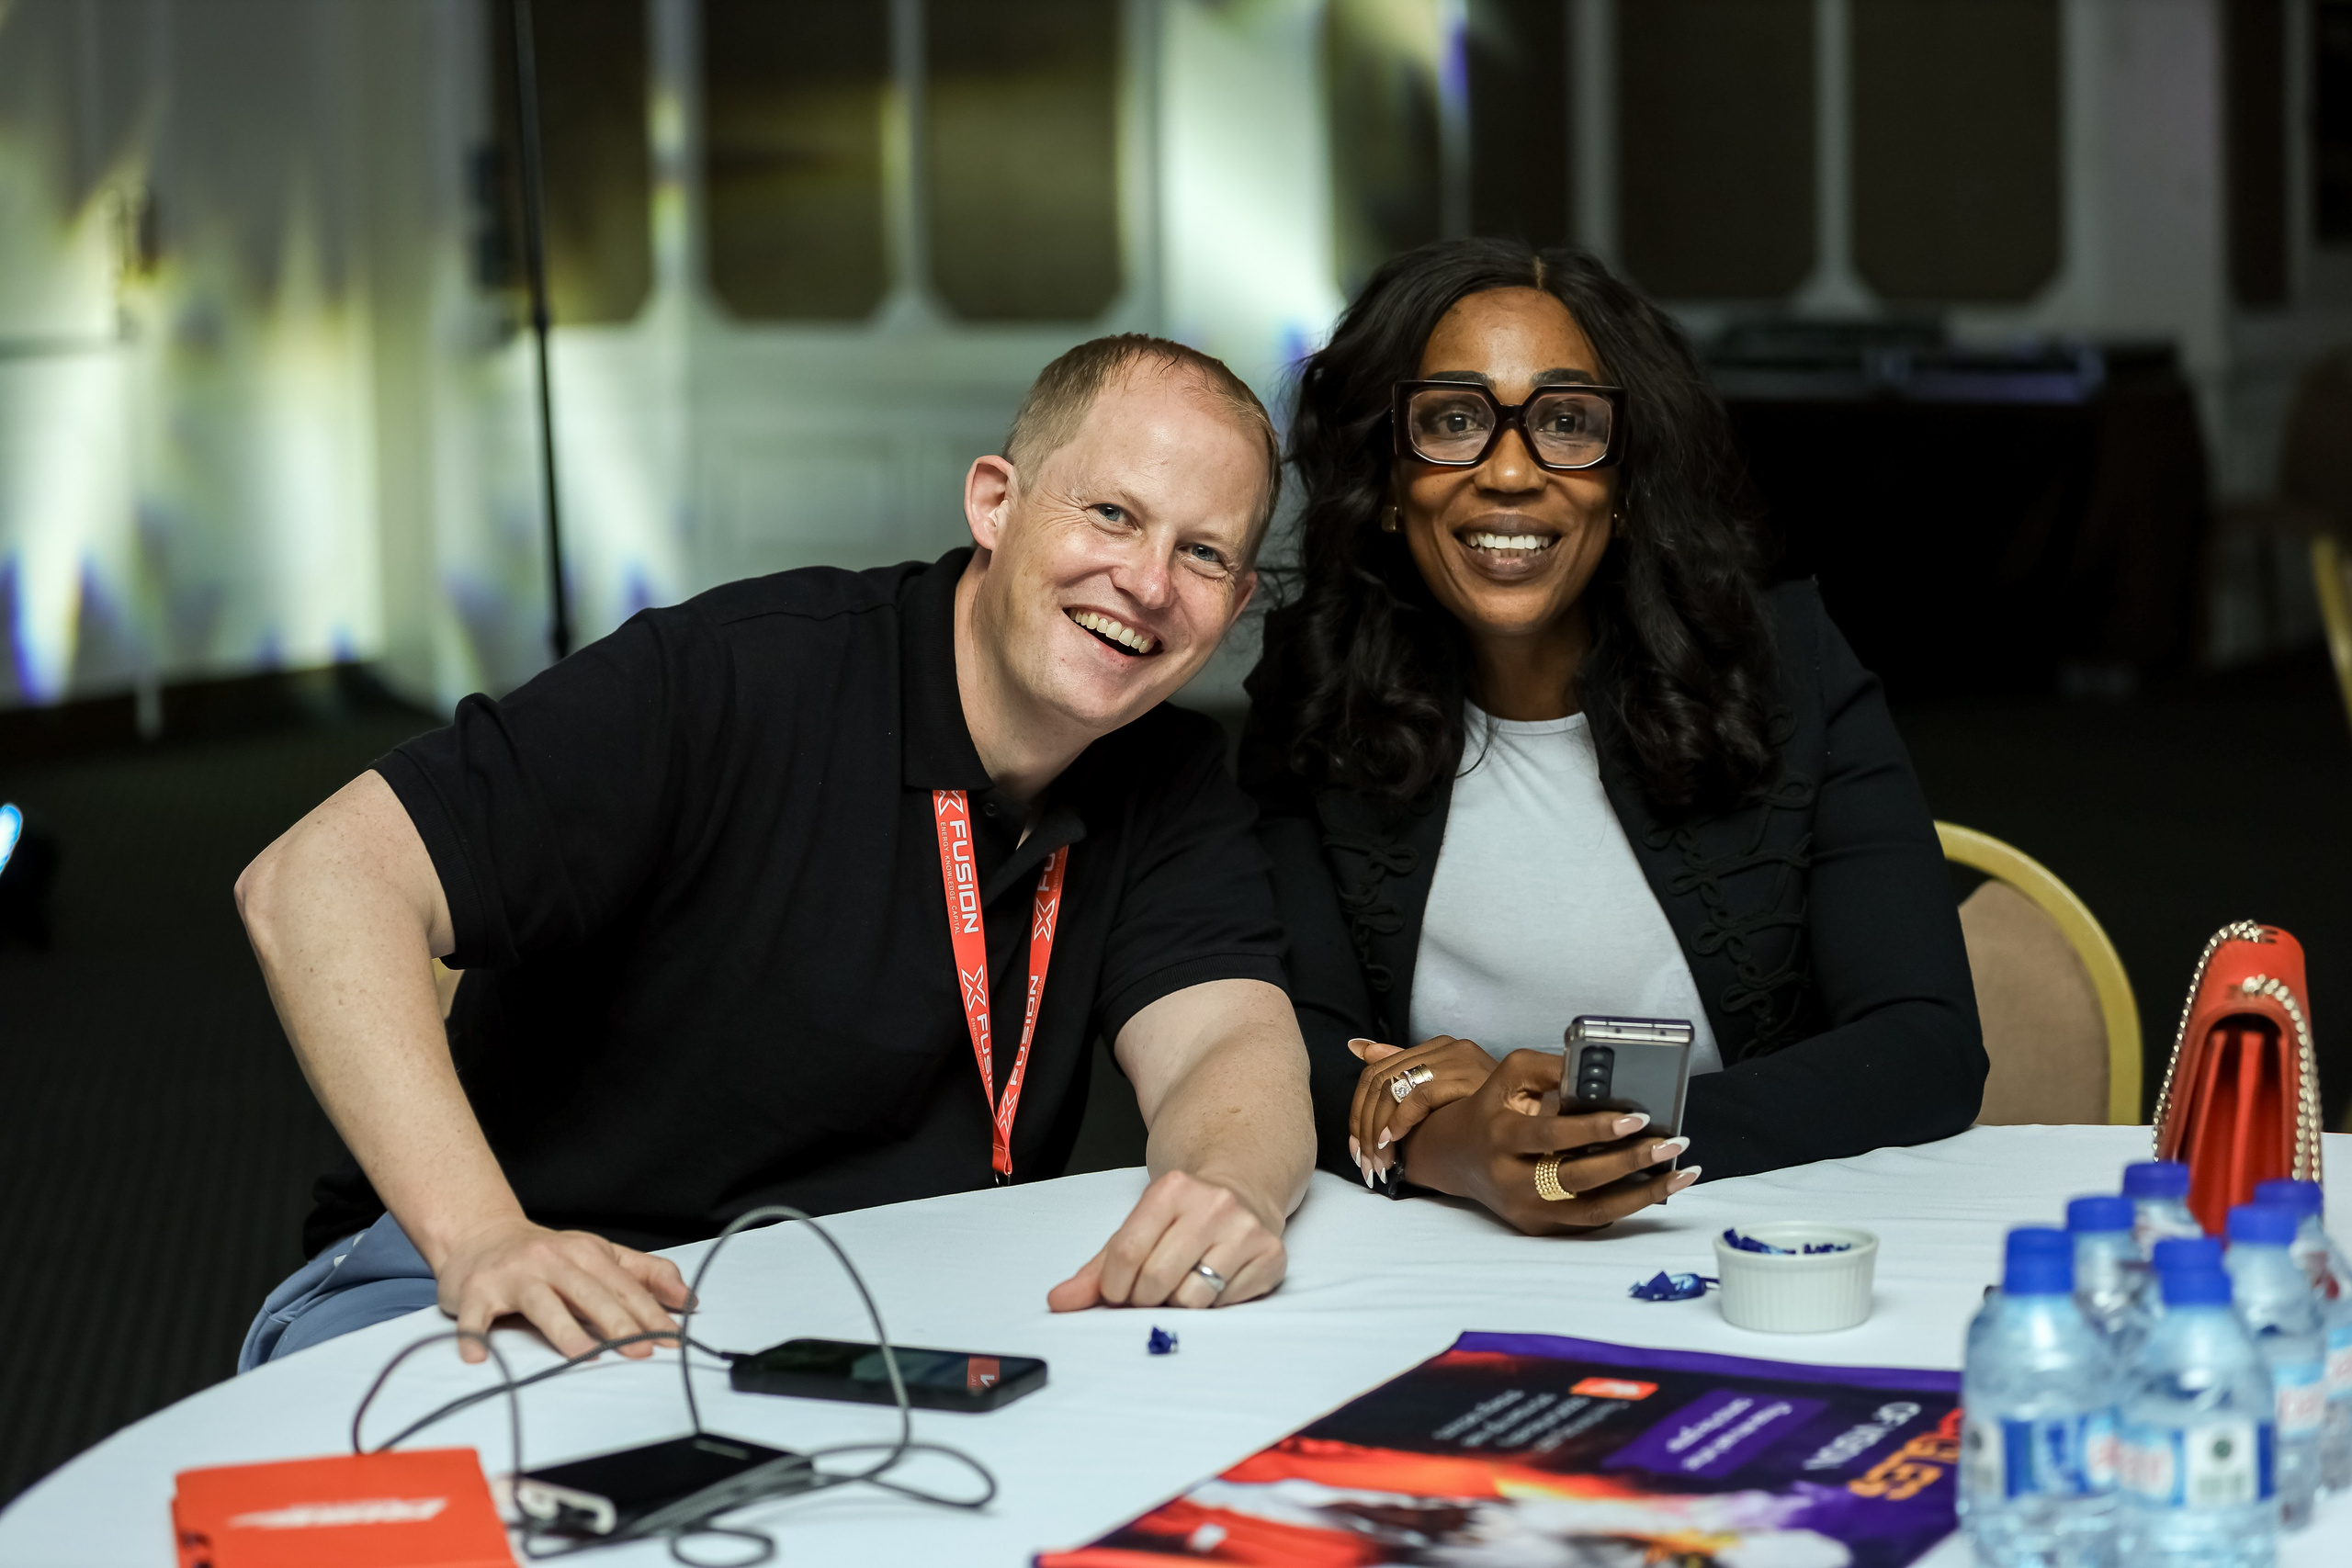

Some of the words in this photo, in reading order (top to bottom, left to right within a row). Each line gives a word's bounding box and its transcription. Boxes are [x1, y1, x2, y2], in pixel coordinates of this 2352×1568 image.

[940, 821, 949, 852] ENERGY.
[951, 905, 959, 935] CAPITAL
[949, 819, 979, 934] FUSION
[1010, 975, 1039, 1086] FUSION
